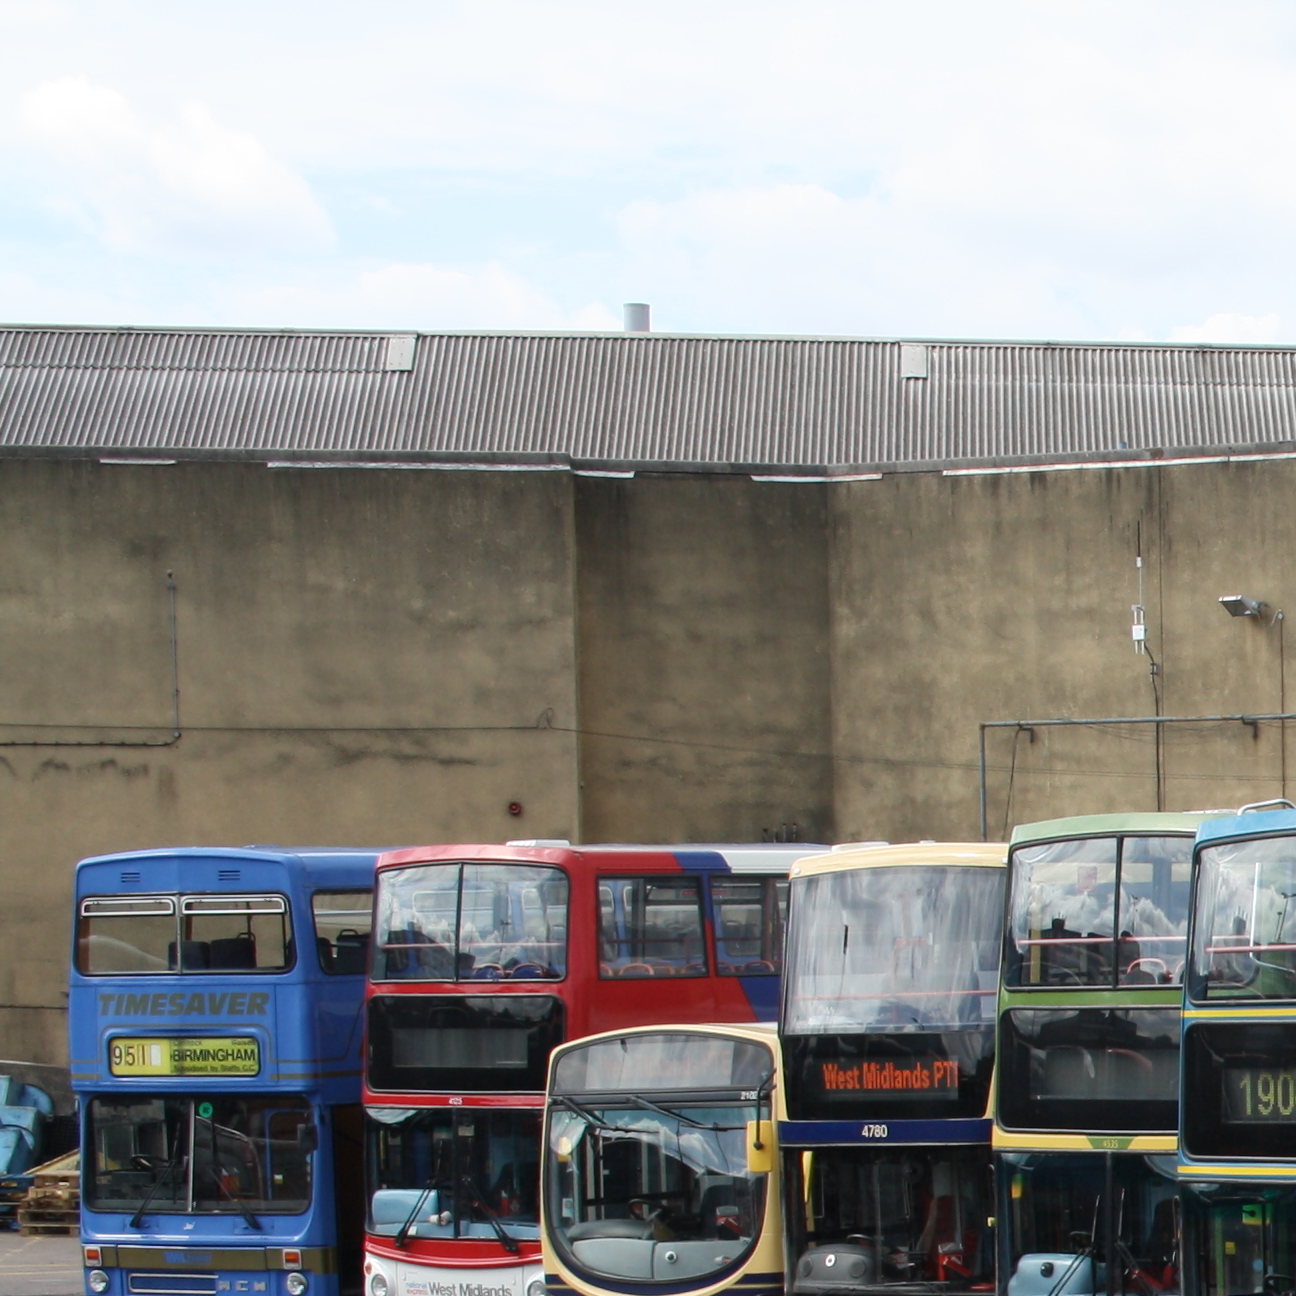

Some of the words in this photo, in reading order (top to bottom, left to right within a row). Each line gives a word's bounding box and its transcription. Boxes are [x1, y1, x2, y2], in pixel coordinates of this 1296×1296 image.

[99, 992, 270, 1016] TIMESAVER
[172, 1048, 256, 1062] BIRMINGHAM
[822, 1063, 860, 1089] West
[863, 1062, 930, 1089] Midlands
[862, 1125, 888, 1137] 4780
[428, 1282, 457, 1296] West
